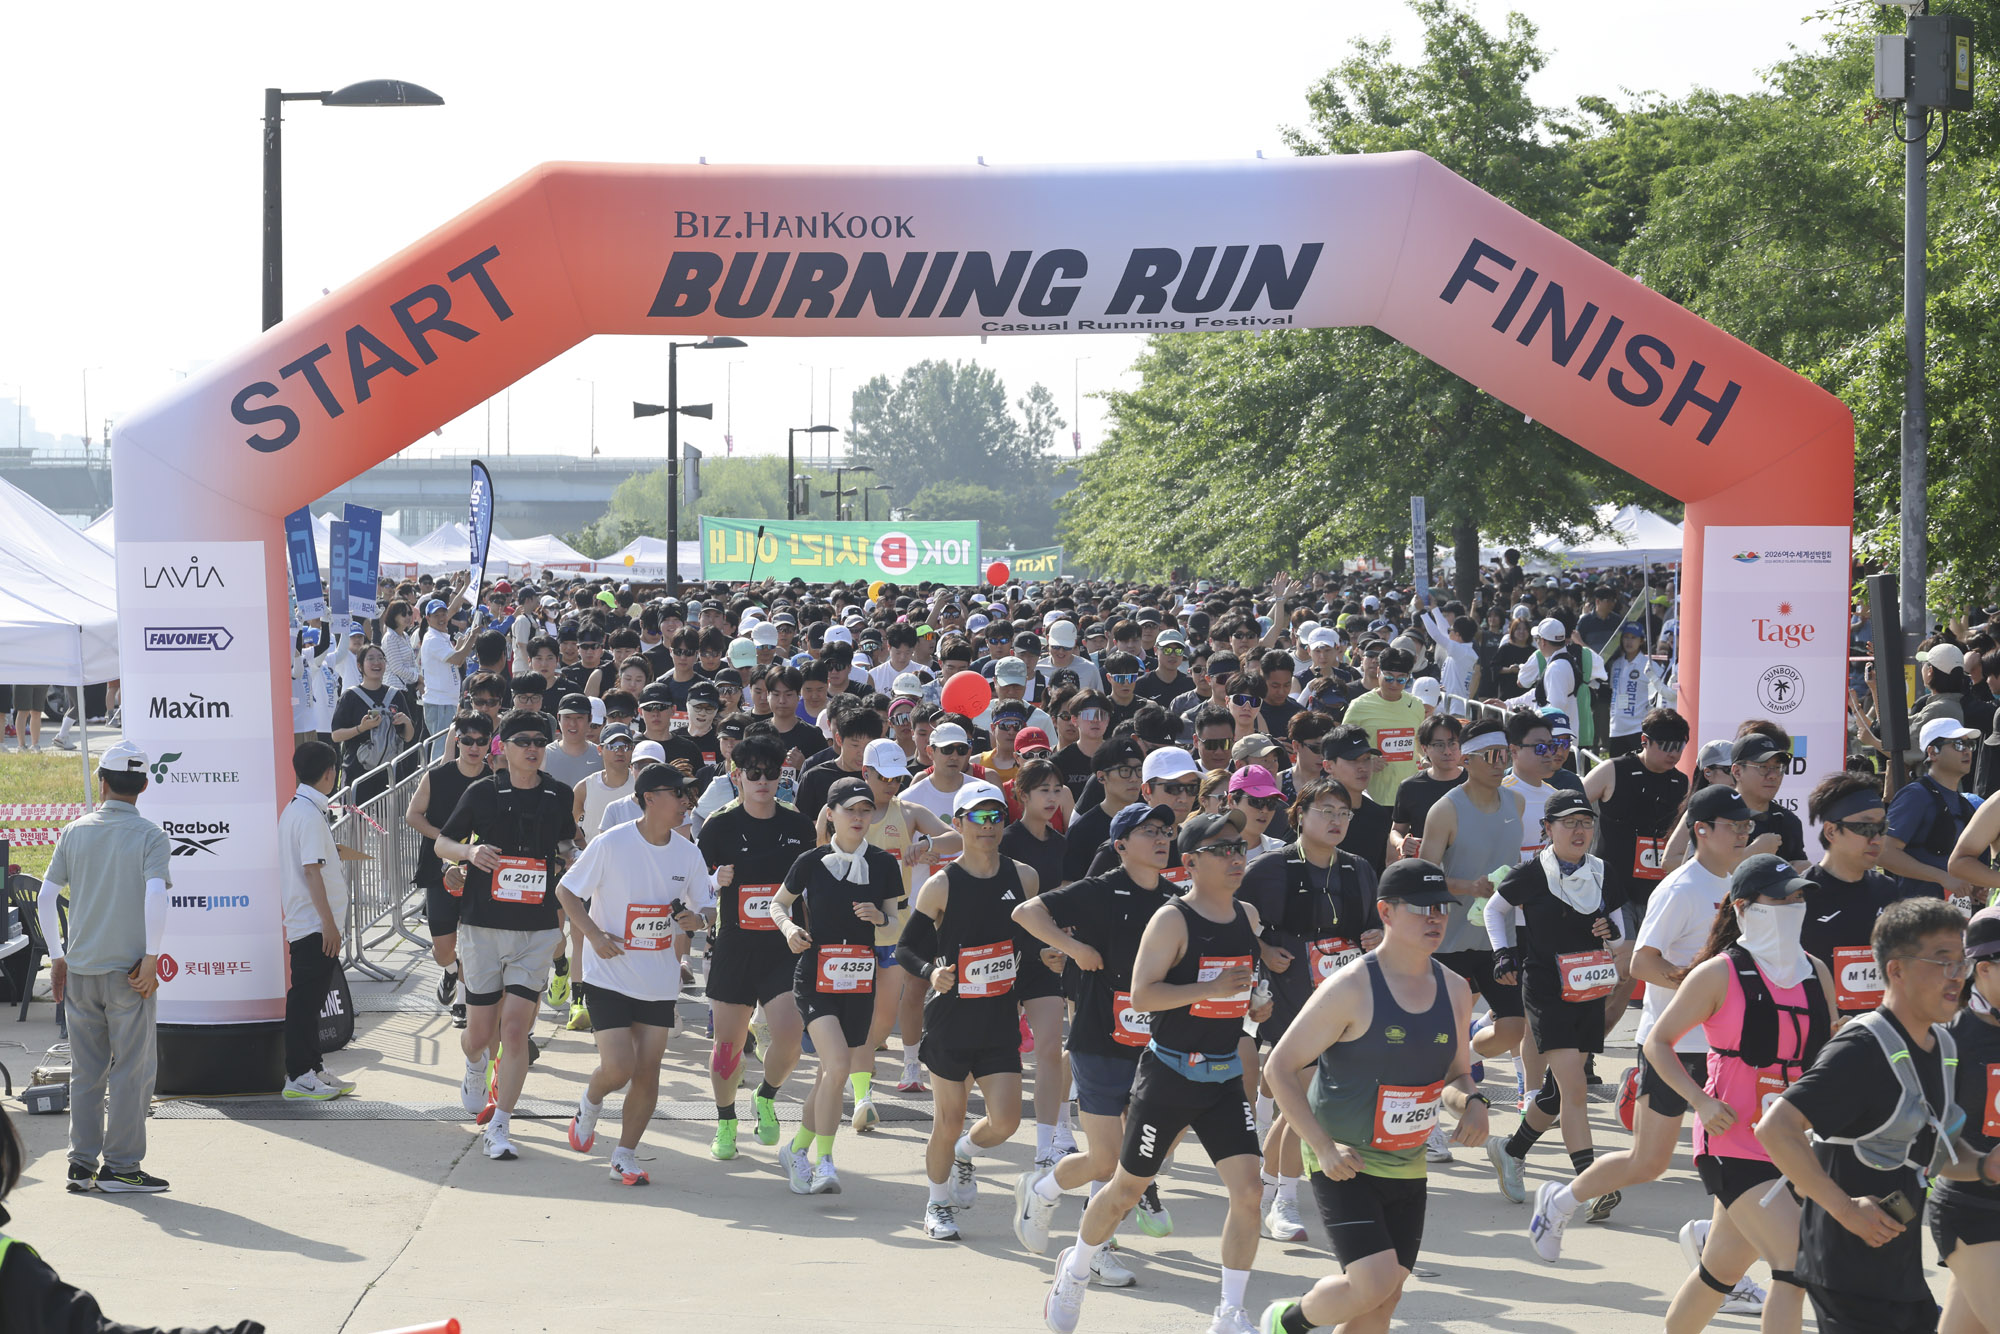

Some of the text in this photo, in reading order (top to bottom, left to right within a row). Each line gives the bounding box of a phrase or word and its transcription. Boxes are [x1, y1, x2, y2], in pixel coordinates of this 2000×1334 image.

[646, 242, 1325, 319] BURNING RUN
[981, 314, 1293, 333] Casual Running Festival
[229, 244, 515, 453] START
[1439, 238, 1742, 446] FINISH
[1752, 618, 1815, 648] Tage
[150, 632, 219, 650] FAVONEX
[1764, 667, 1800, 682] SUNBODY
[149, 692, 230, 718] Maxim
[1766, 700, 1797, 711] TANNING
[170, 771, 240, 783] NEWTREE
[163, 820, 230, 836] Reebok
[20, 832, 48, 841] 안전제일
[514, 873, 544, 884] 2017
[185, 961, 252, 976] 롯데웰푸드
[841, 962, 872, 972] 4353
[984, 959, 1012, 974] 1296
[1324, 960, 1333, 969] W
[1585, 968, 1615, 981] 4024
[1848, 972, 1858, 980] M
[1391, 1114, 1402, 1123] M
